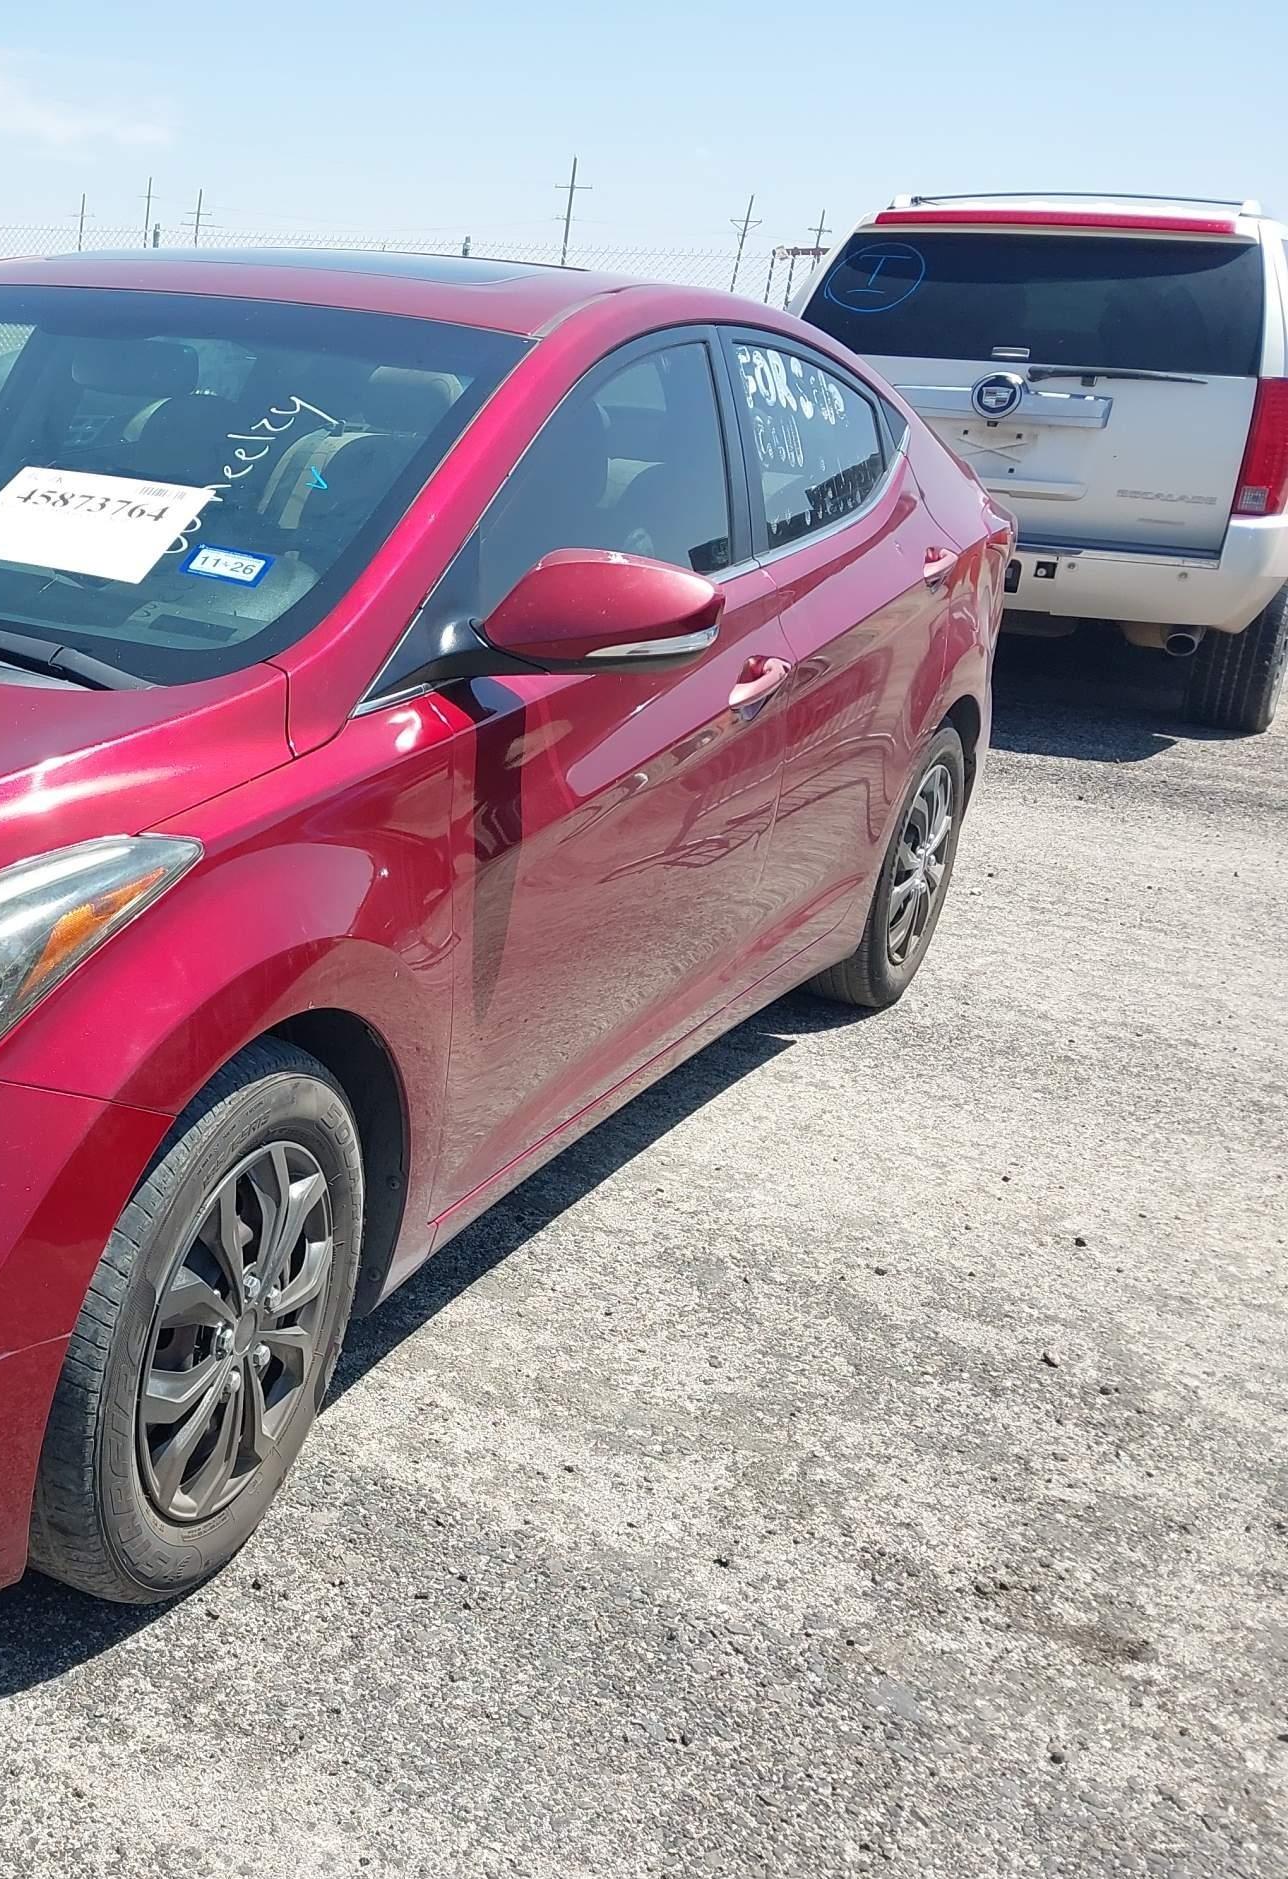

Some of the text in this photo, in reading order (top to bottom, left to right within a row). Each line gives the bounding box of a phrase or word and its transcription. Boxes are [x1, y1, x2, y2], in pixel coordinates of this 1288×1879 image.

[736, 346, 798, 413] FOR
[16, 488, 170, 522] 45873764
[109, 1320, 171, 1579] STARFIRE
